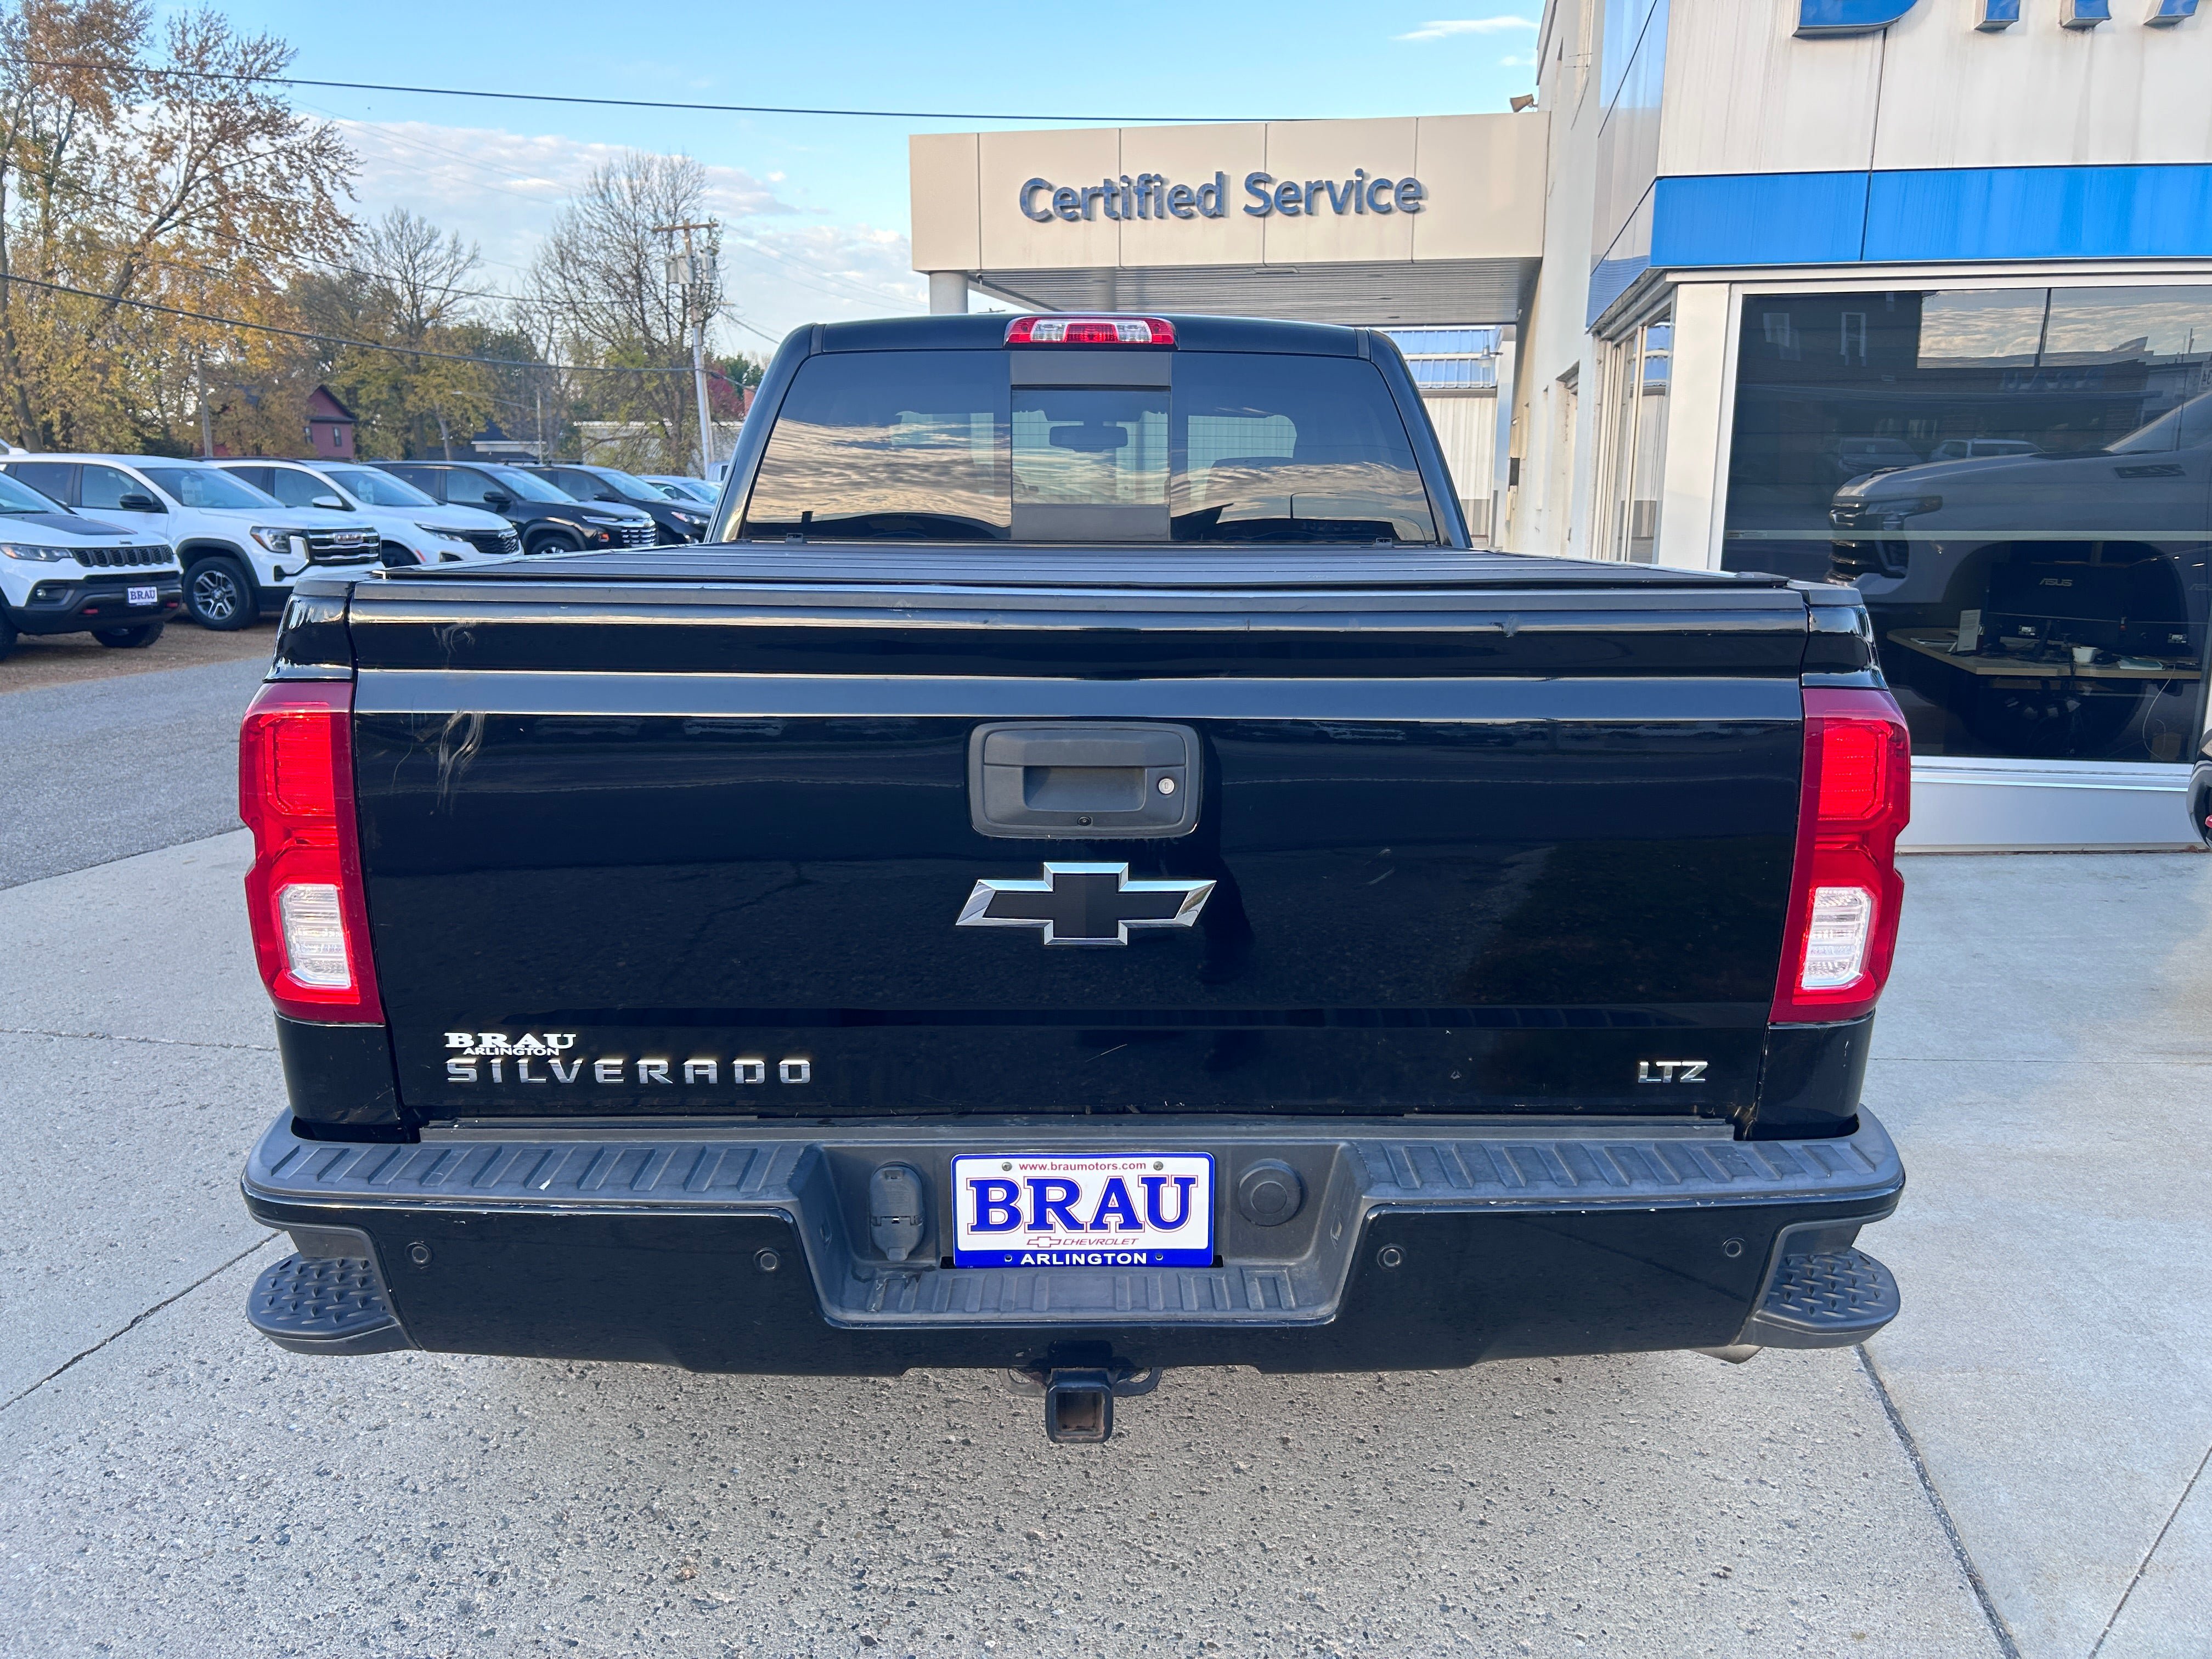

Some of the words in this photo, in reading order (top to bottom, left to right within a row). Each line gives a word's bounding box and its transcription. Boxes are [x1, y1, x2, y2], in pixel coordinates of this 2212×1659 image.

[1019, 171, 1224, 223] Certified
[1243, 168, 1423, 217] Service
[2039, 578, 2073, 586] ASUS
[129, 590, 155, 600] BRAU
[444, 1032, 577, 1049] BRAU
[462, 1047, 560, 1056] ARLINGTON
[445, 1058, 811, 1084] SILVERADO
[1638, 1061, 1708, 1083] LTZ
[1018, 1161, 1147, 1172] www.braumotors.com
[966, 1175, 1199, 1234] BRAU
[1020, 1252, 1147, 1265] ARLINGTON
